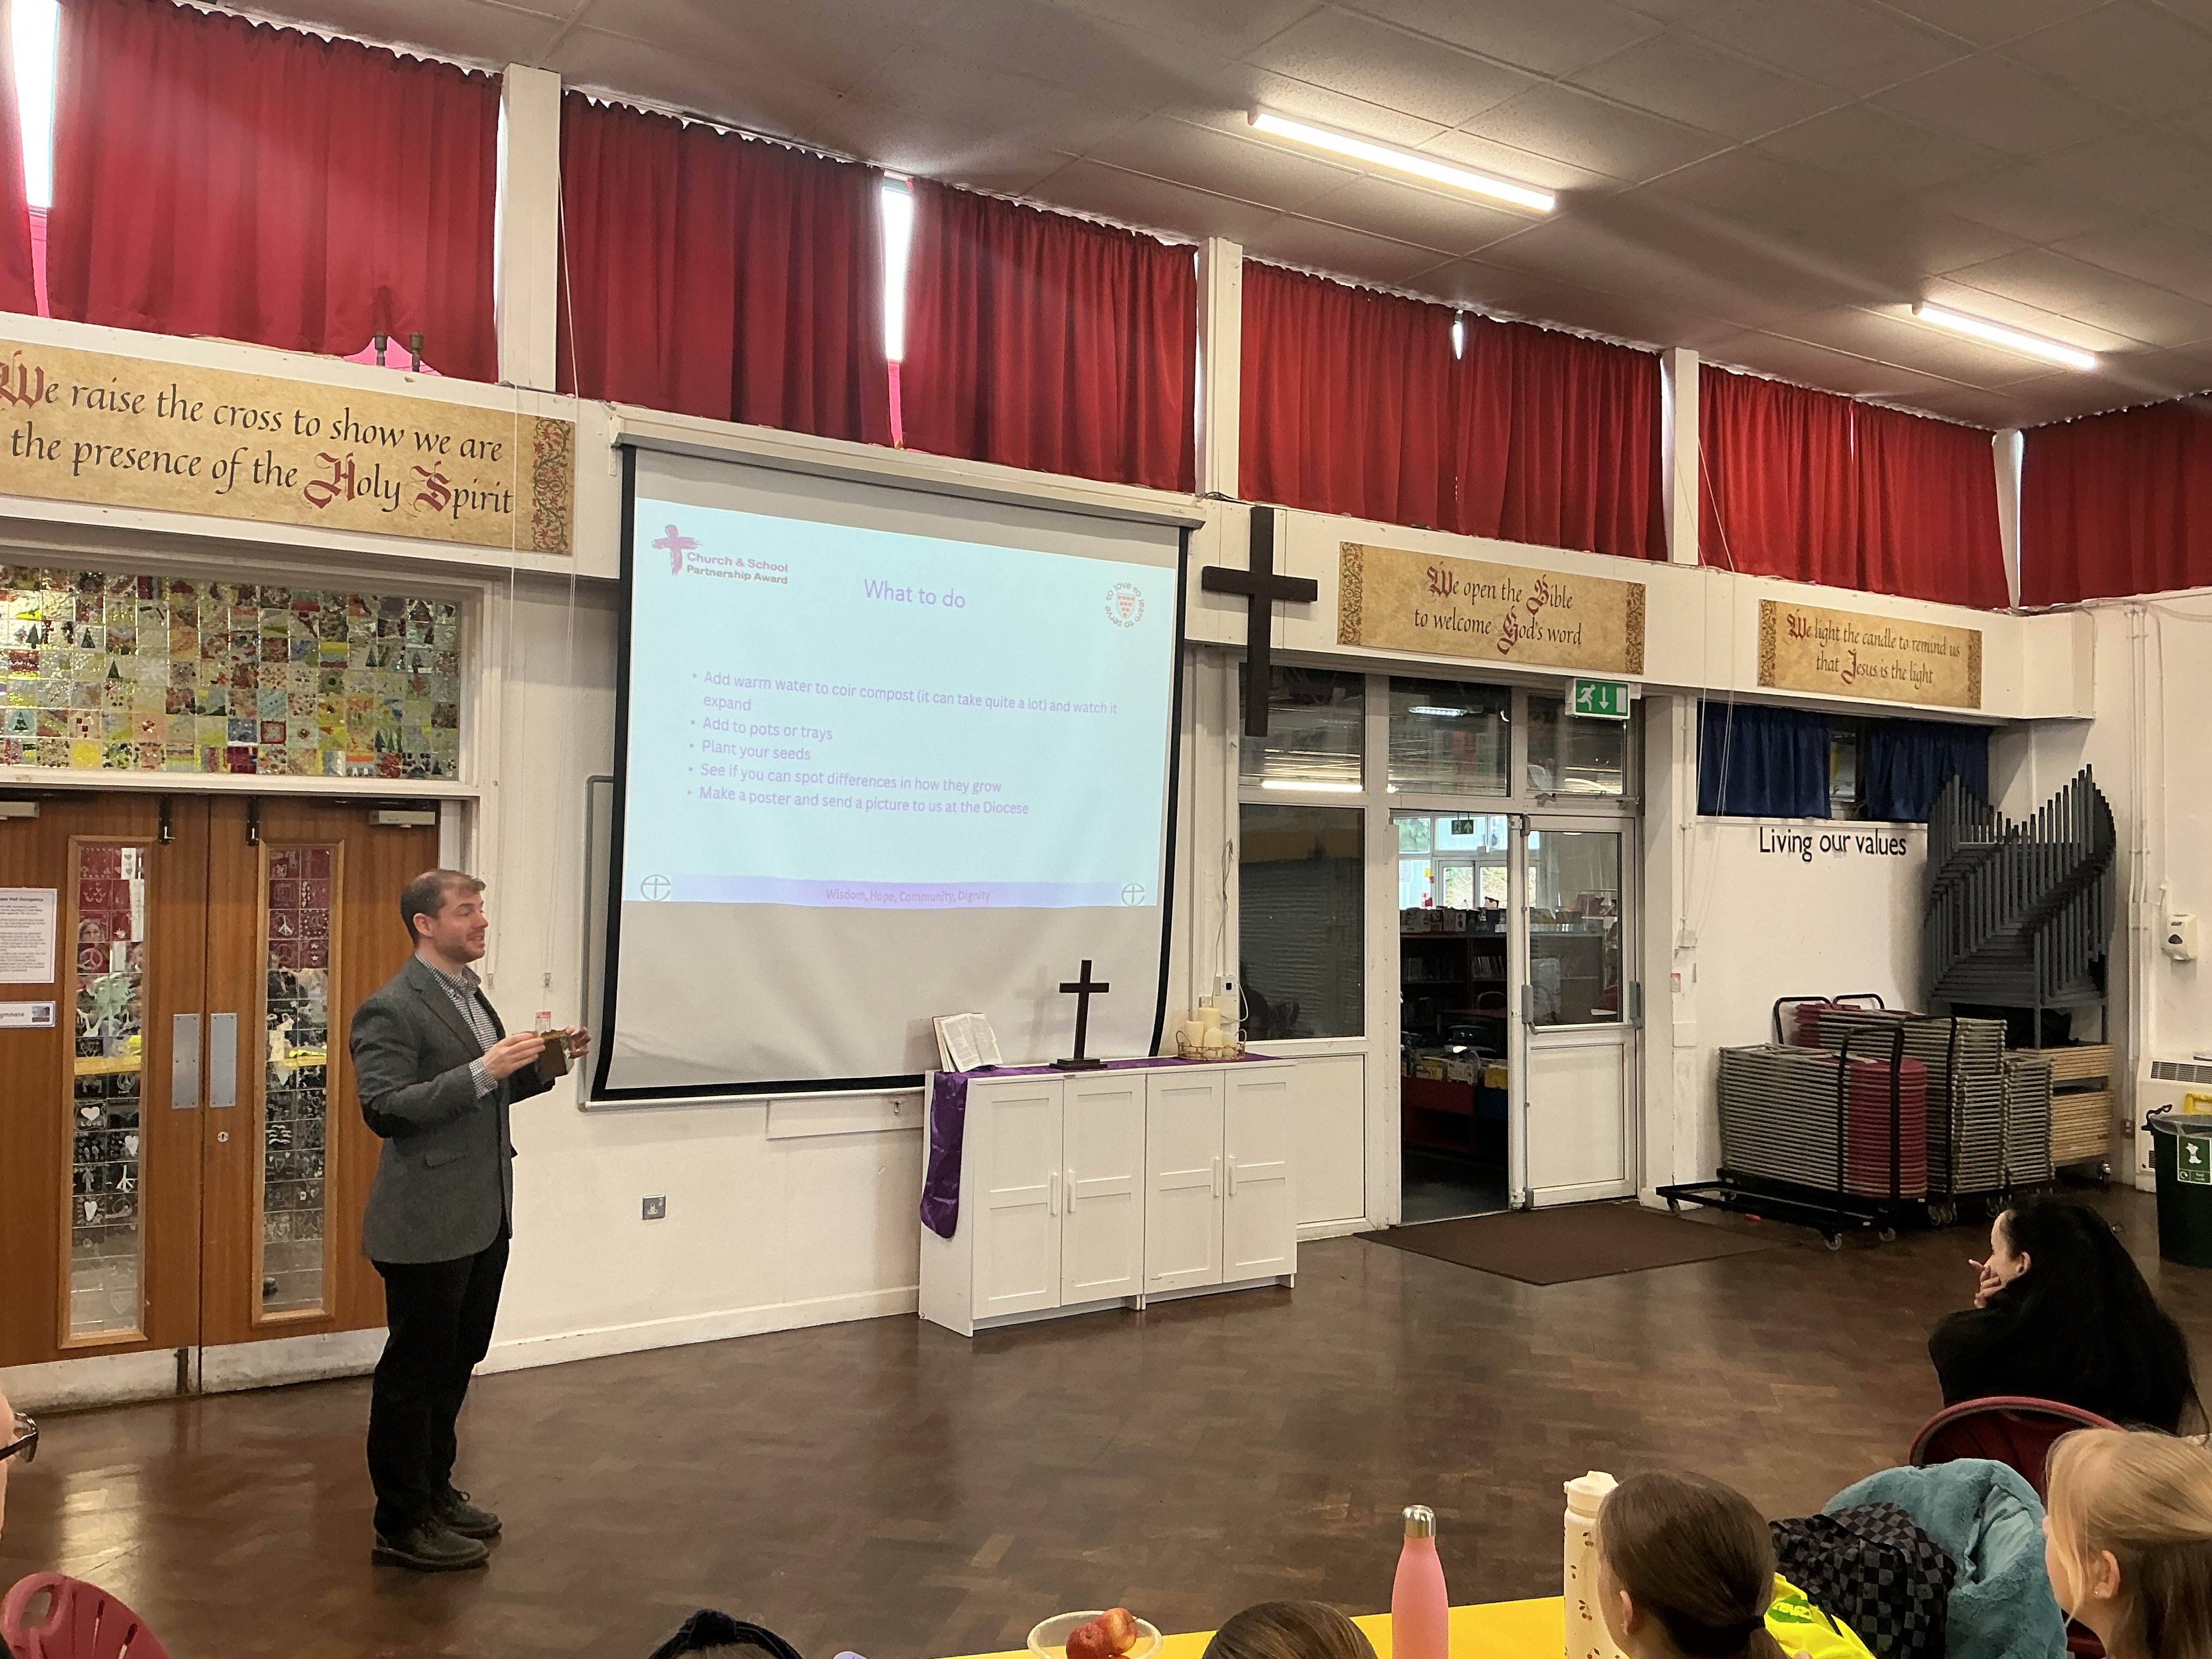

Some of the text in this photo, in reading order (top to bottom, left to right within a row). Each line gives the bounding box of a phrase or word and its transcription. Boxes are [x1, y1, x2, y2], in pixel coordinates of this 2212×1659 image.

[0, 350, 502, 461] We raise the cross to show we are
[11, 420, 514, 520] the presence of the Holy Spirit
[686, 564, 788, 585] Partnership Award
[687, 551, 788, 573] Church & School
[864, 578, 966, 608] What to do
[1113, 582, 1132, 592] love
[1426, 561, 1573, 616] We open the Bible
[1105, 606, 1123, 627] serve
[1135, 599, 1145, 622] learn
[1414, 606, 1582, 655] to welcome God's word
[1786, 608, 1961, 657] We light the candle to remind us
[1816, 648, 1934, 690] that Jesus is the light
[704, 670, 1118, 714] Add warm water to coir compost (it can take quite a lot) and watch it
[704, 695, 752, 712] expand
[703, 716, 833, 743] Add to pots or trays
[702, 739, 811, 761] Plant your seeds
[701, 763, 1002, 795] See if you can spot differences in how they grow
[700, 786, 1029, 815] Make a poster and send a picture to us at the Diocese
[1759, 826, 1906, 862] Living our values
[825, 888, 991, 904] Wisdom, Hope, Community, Dignity
